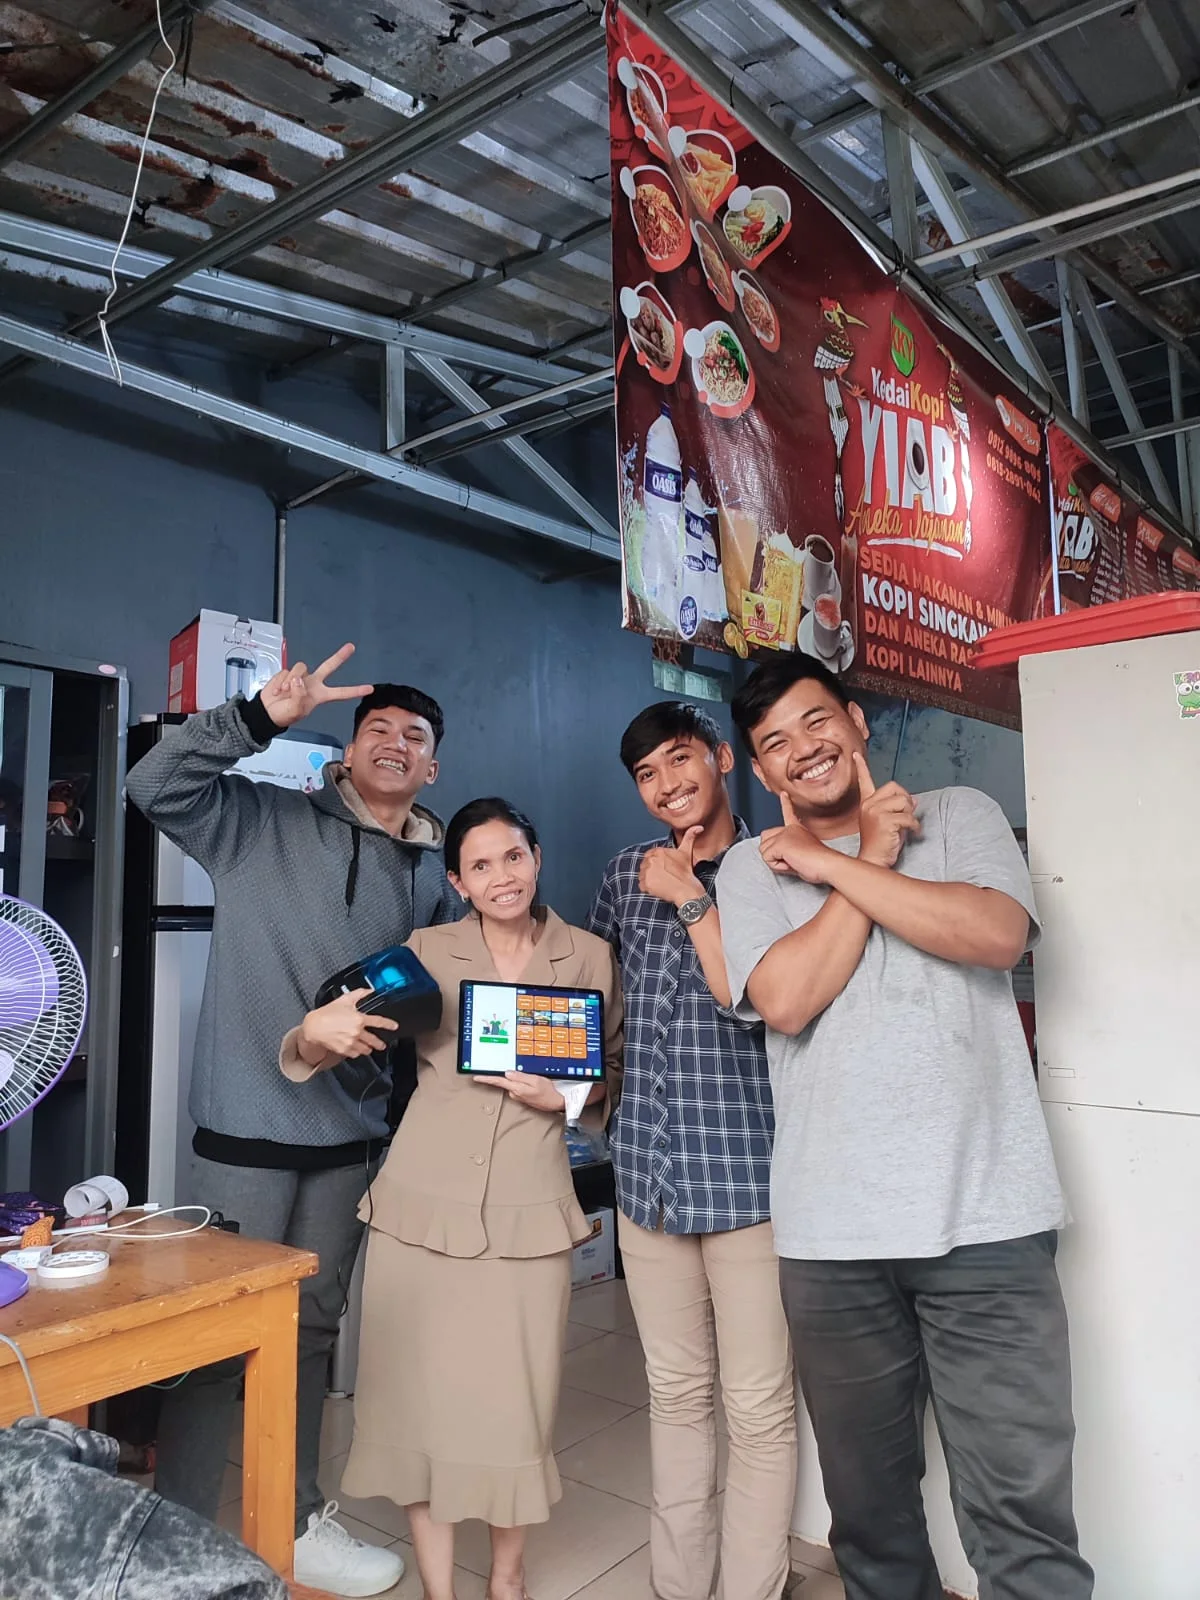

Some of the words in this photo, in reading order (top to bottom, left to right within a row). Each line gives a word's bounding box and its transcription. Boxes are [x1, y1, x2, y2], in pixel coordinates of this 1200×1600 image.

[858, 398, 957, 516] YIAB
[652, 473, 677, 496] OASIS
[845, 485, 903, 537] Aneka
[909, 494, 965, 555] Jajanan
[860, 546, 909, 585] SEDIA
[914, 570, 973, 613] MAKANAN
[976, 600, 984, 620] &
[862, 573, 914, 620] KOPI
[865, 611, 899, 645] DAN
[904, 625, 948, 659] ANEKA
[866, 642, 904, 675] KOPI
[909, 656, 962, 692] LAINNYA
